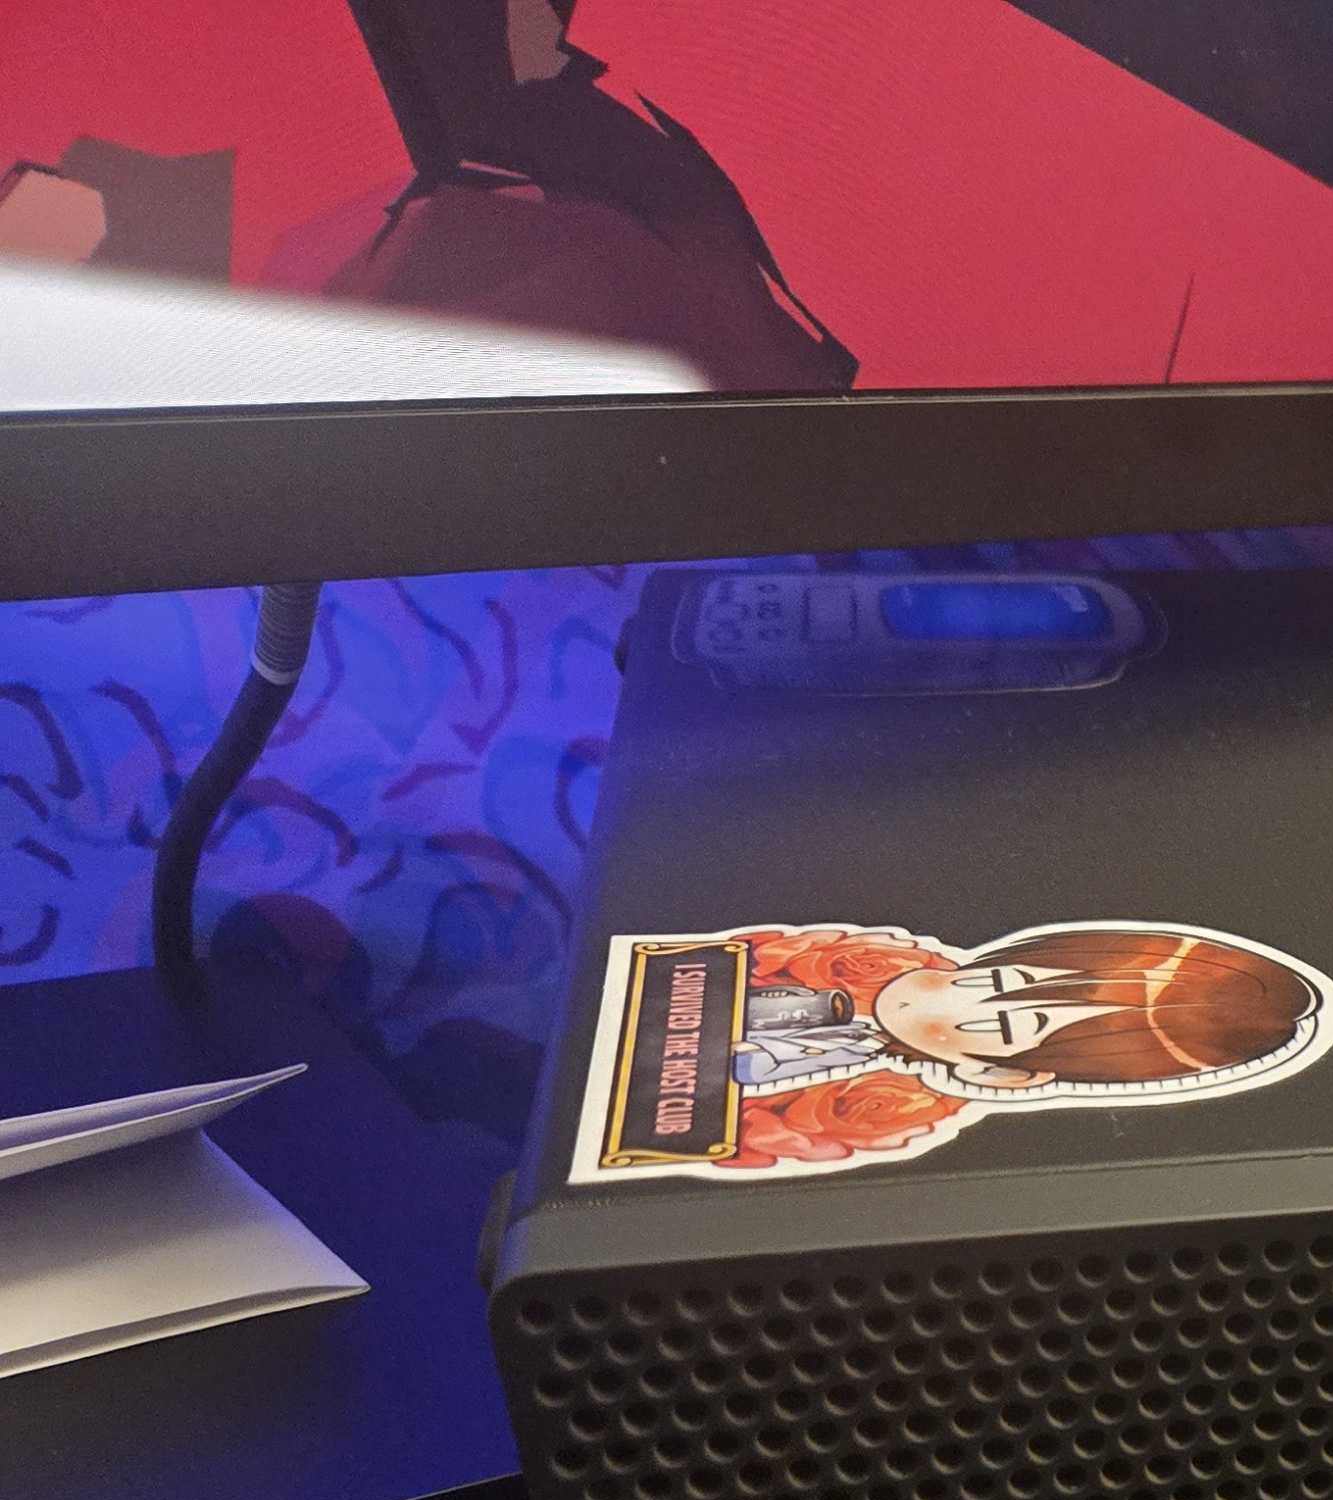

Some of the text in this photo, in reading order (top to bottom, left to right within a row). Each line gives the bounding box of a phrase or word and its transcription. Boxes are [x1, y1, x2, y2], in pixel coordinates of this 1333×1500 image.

[668, 970, 707, 1030] SURVIVED
[664, 1031, 700, 1057] THE
[659, 1059, 698, 1095] HOST
[655, 1097, 695, 1135] CLUB
